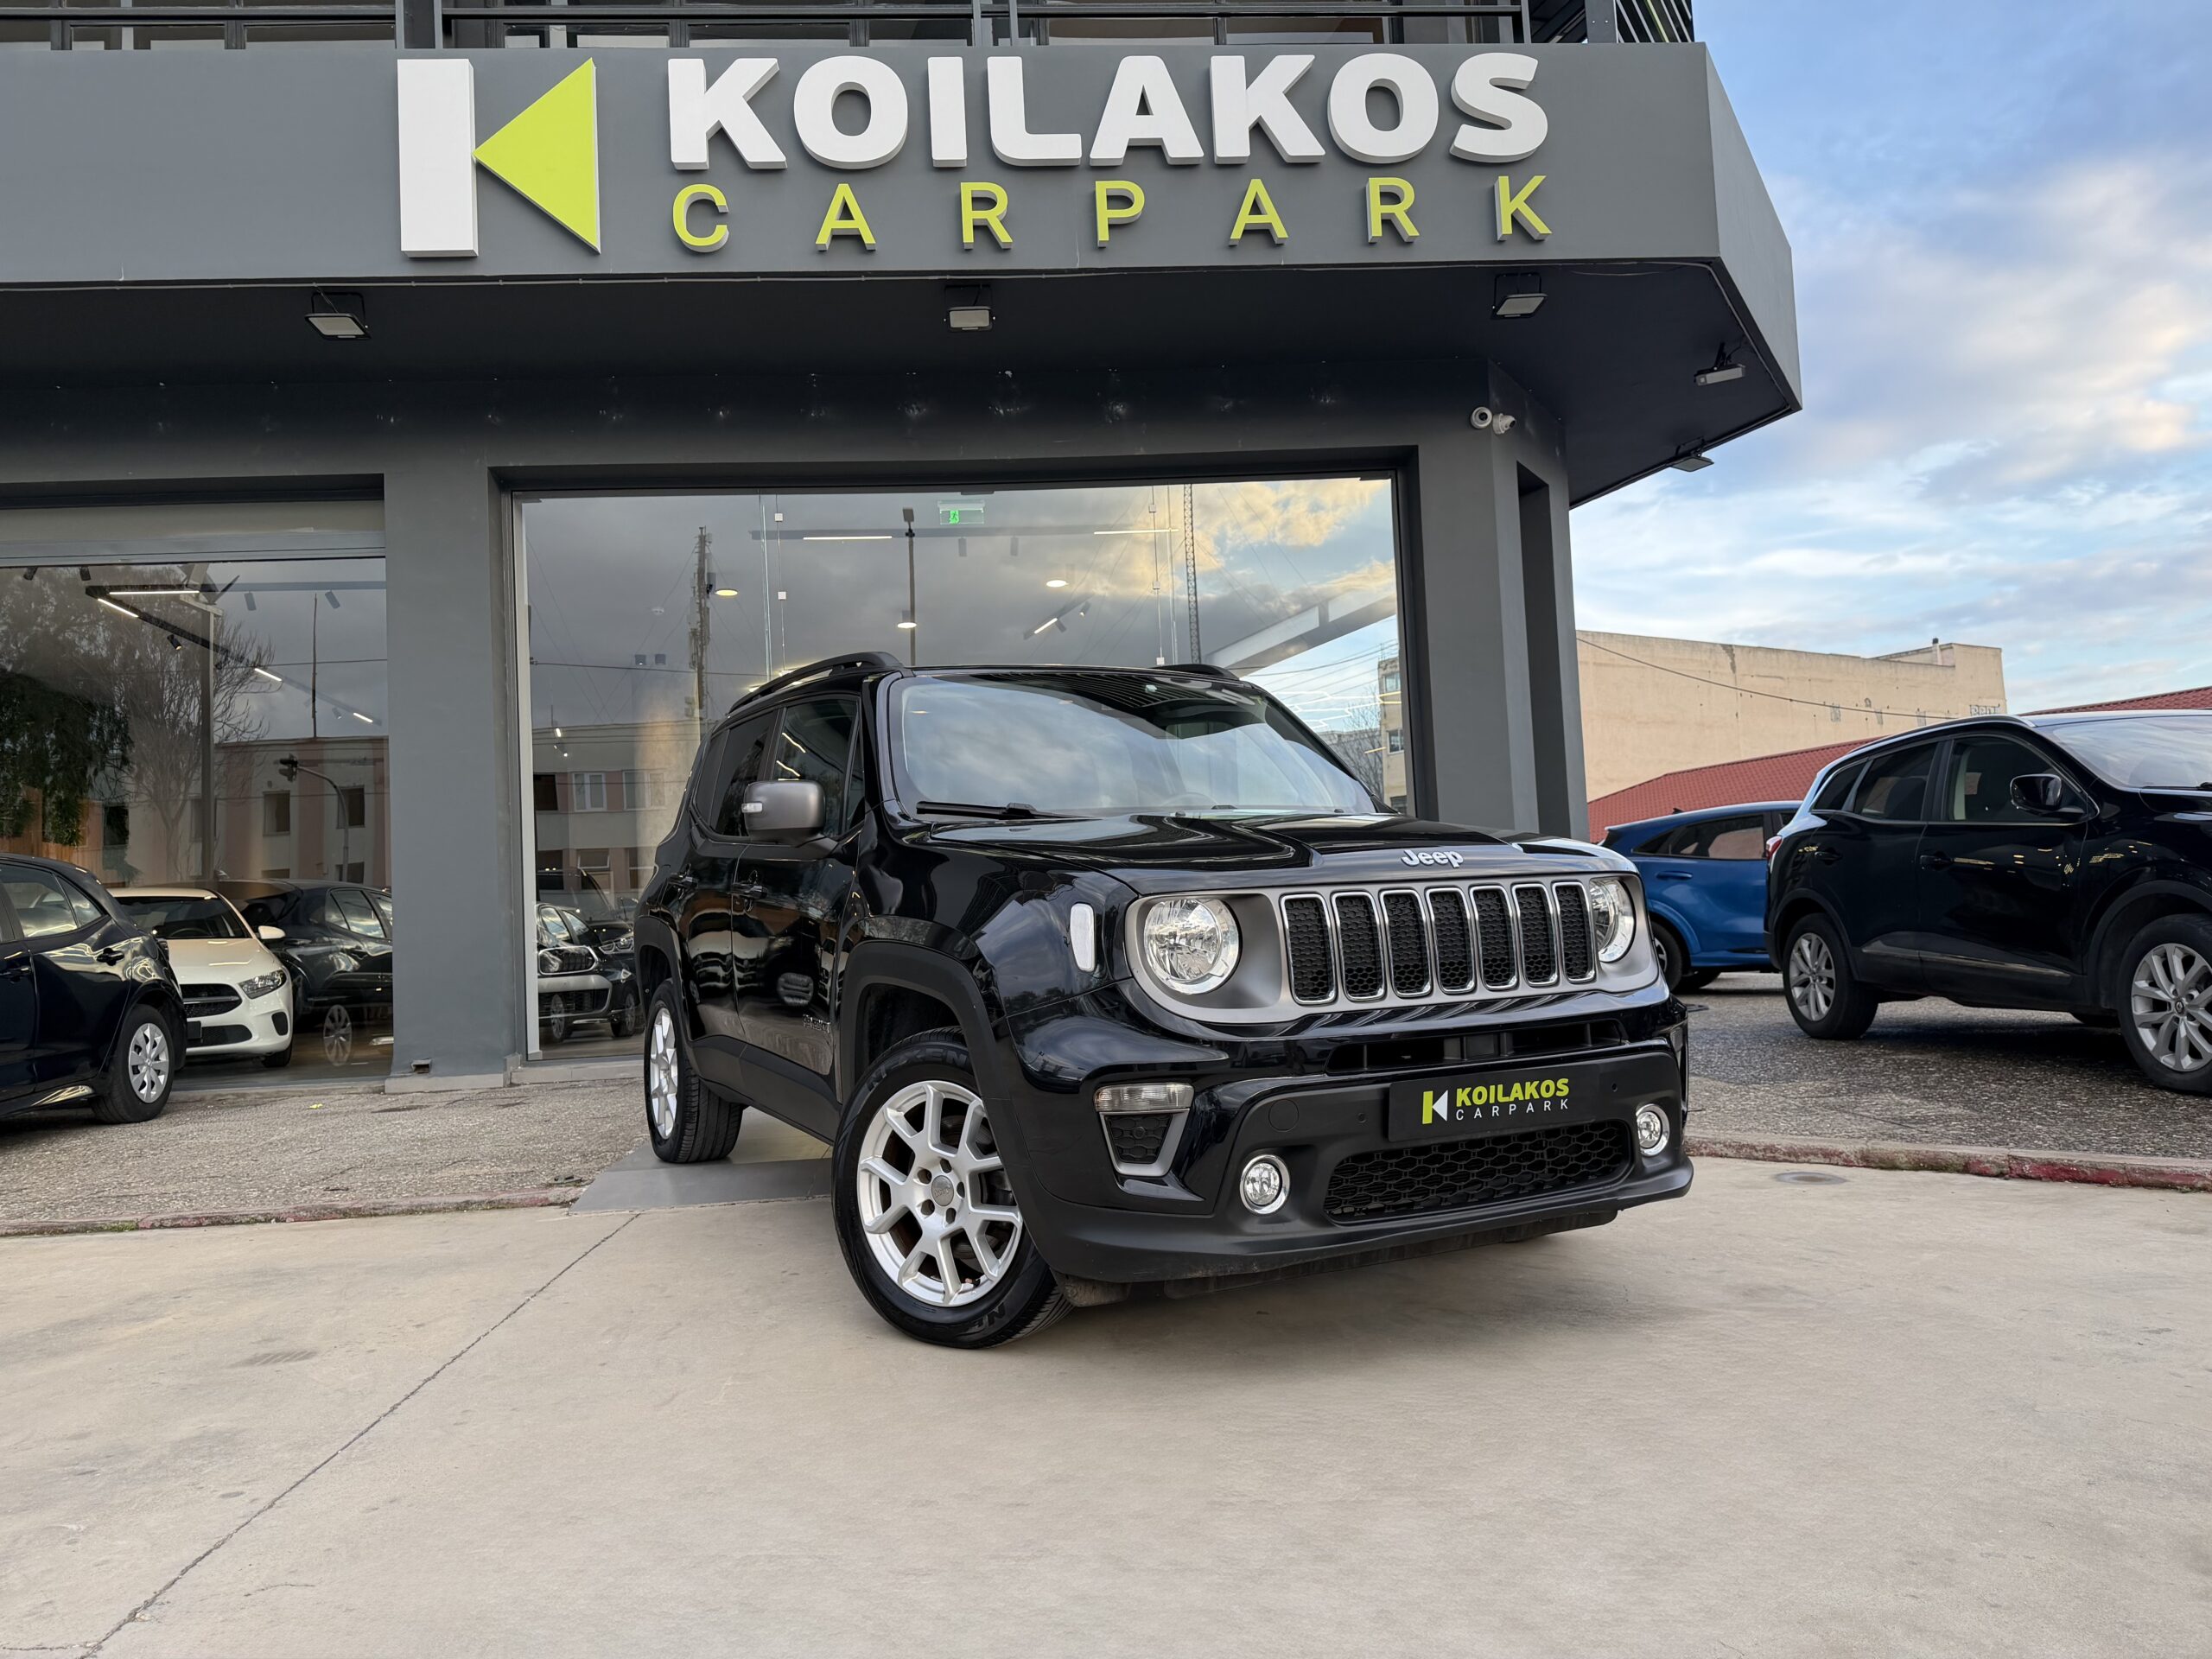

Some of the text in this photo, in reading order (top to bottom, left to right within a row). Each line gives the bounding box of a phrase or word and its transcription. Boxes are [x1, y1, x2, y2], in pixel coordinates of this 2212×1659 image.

[668, 53, 1548, 170] KOILAKOS
[671, 175, 1553, 253] CARPARK
[1401, 849, 1464, 868] Jeep
[1456, 1078, 1570, 1108] KOILAKOS
[1455, 1098, 1569, 1121] CARPARK
